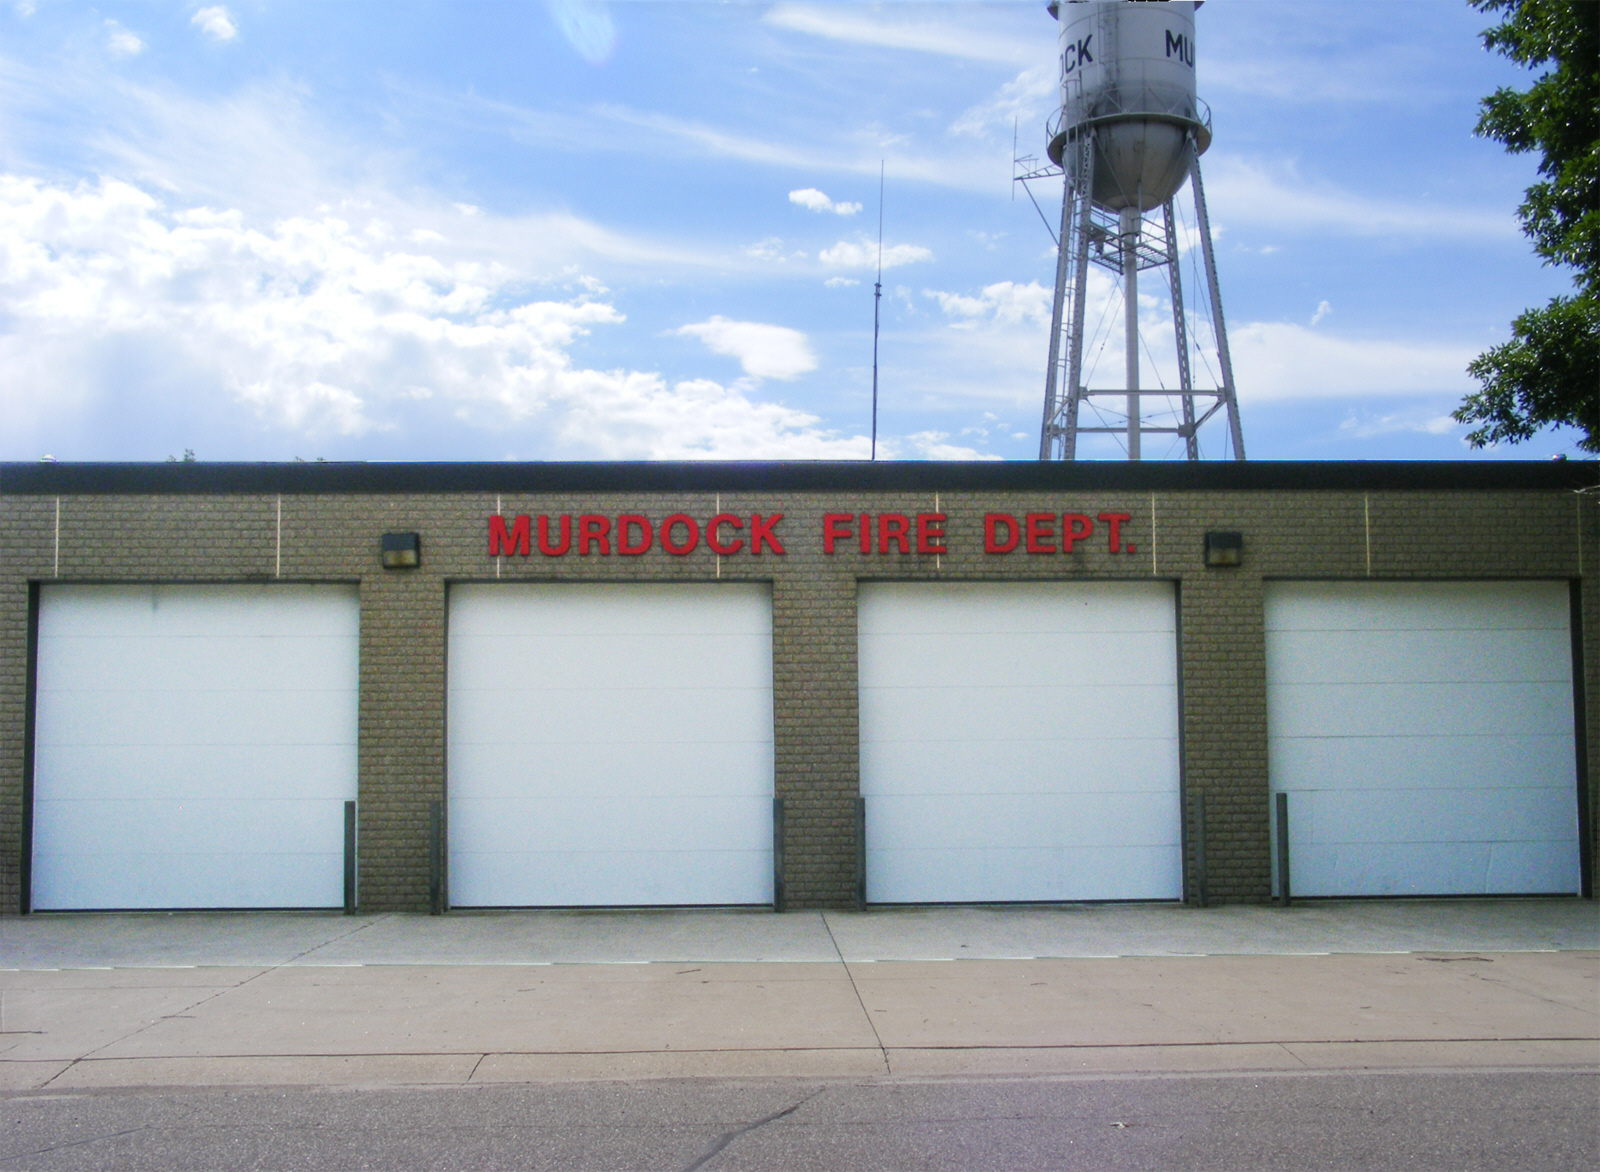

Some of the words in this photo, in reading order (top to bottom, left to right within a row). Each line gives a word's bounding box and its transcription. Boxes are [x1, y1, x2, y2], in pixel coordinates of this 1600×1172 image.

[1165, 29, 1193, 68] MU
[488, 513, 785, 556] MURDOCK
[823, 512, 947, 555] FIRE
[984, 512, 1136, 554] DEPT.
